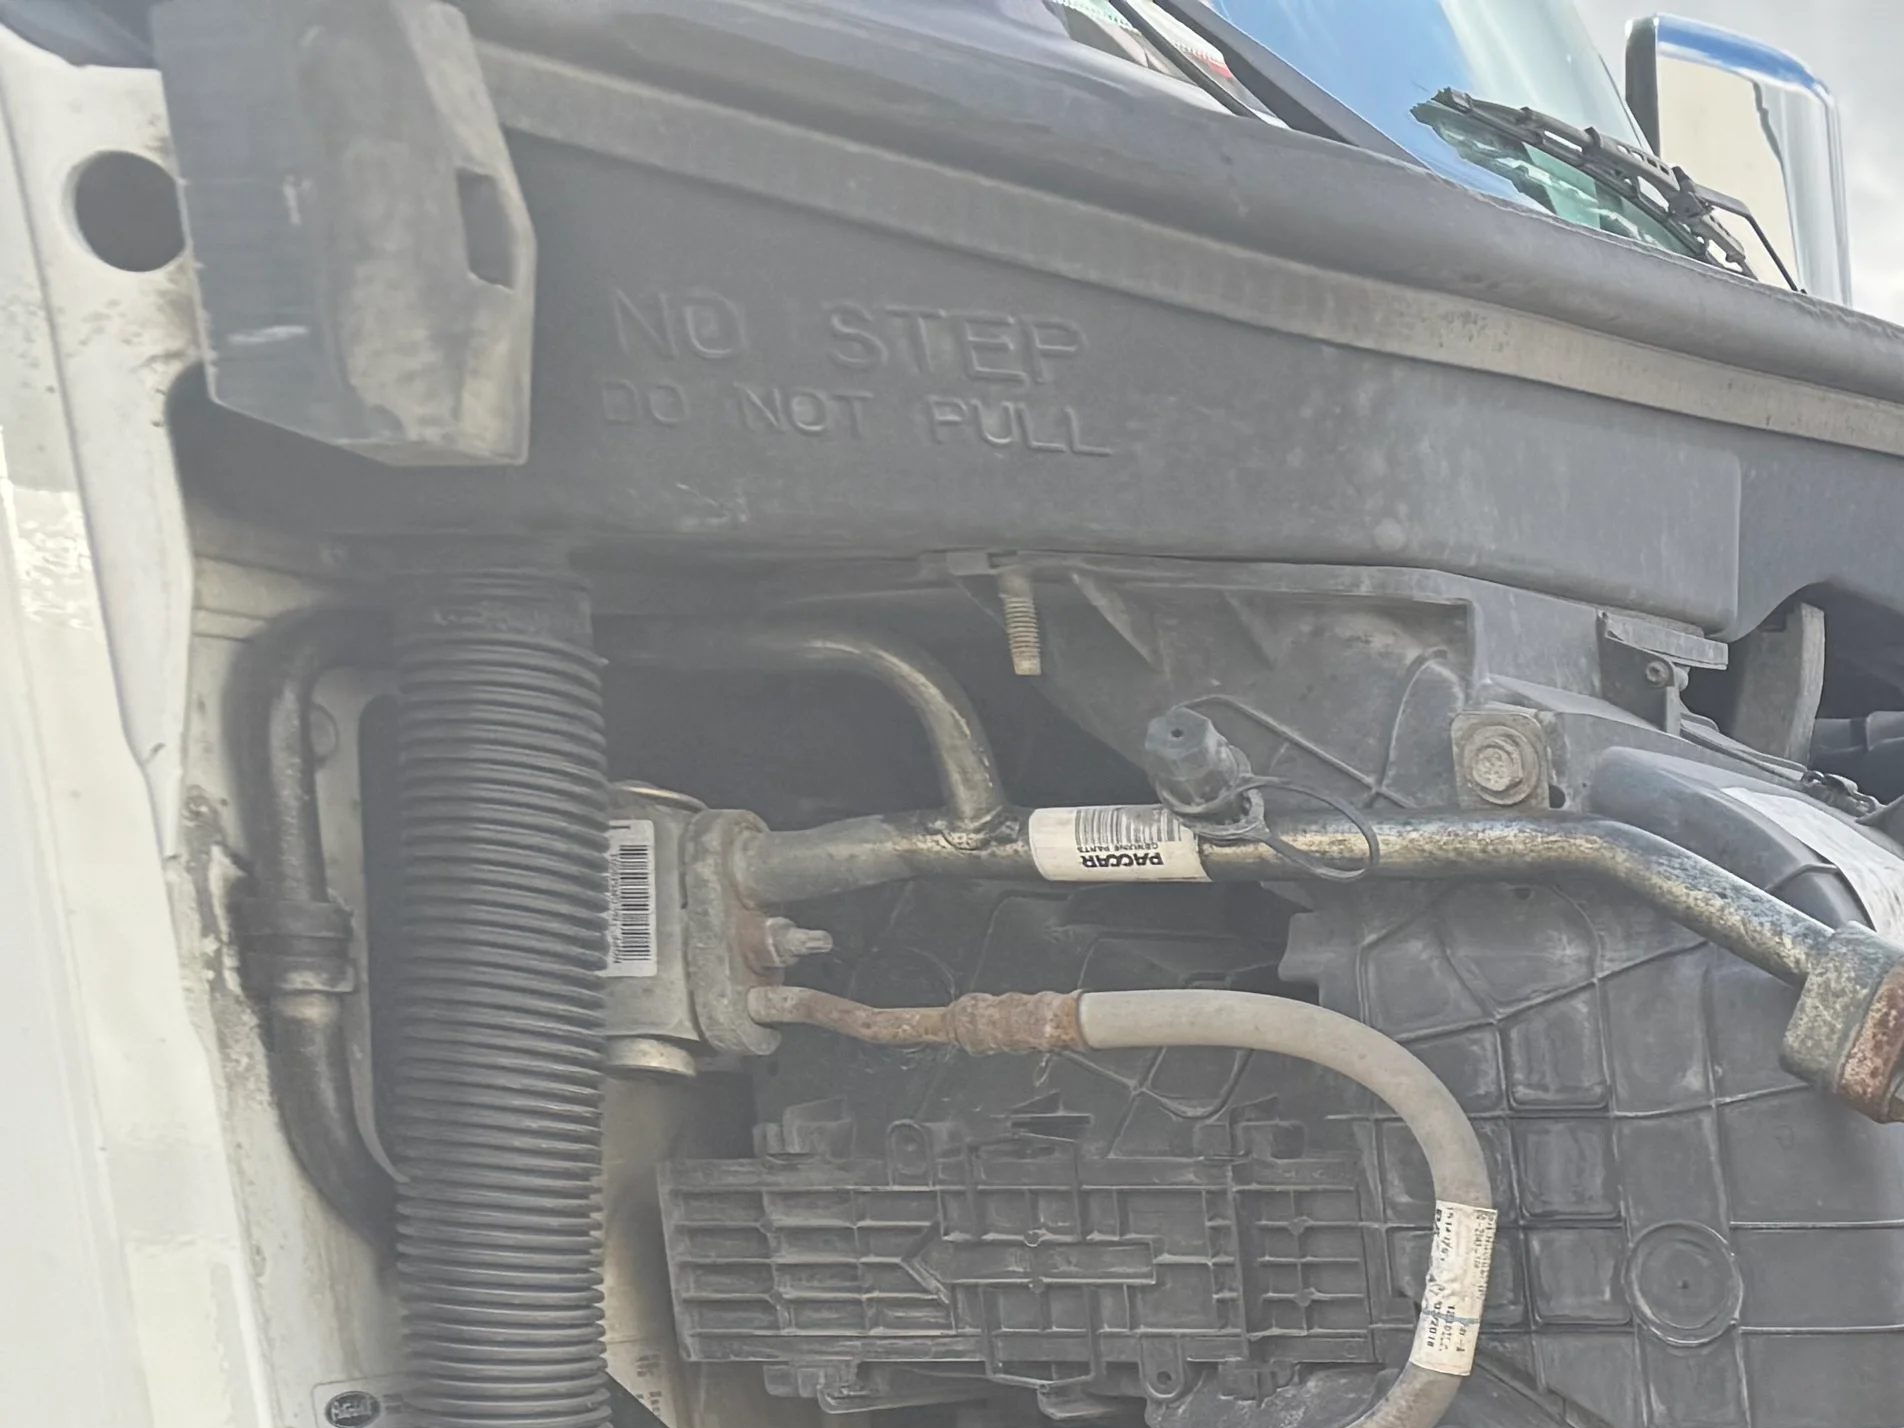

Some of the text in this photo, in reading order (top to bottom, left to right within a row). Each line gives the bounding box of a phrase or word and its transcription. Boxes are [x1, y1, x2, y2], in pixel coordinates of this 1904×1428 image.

[612, 287, 1088, 385] NO STEP
[602, 379, 1113, 457] DO NOT PULL
[1080, 853, 1164, 868] PACCAR
